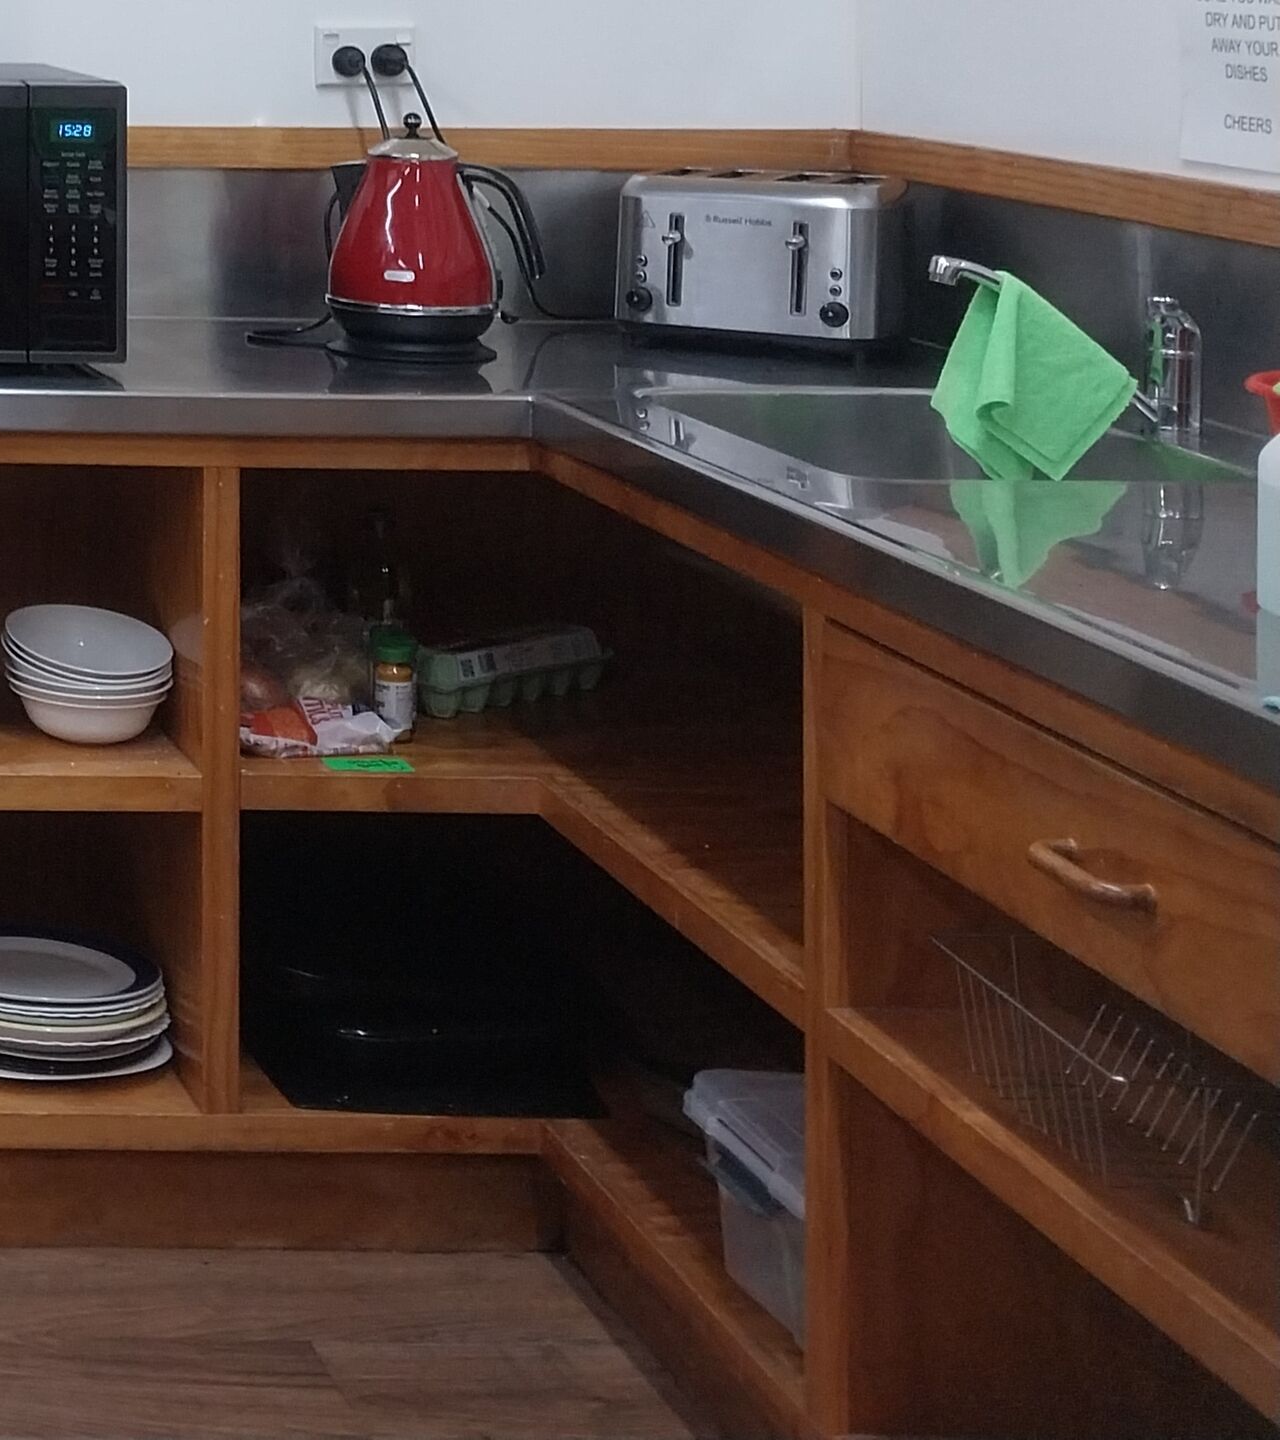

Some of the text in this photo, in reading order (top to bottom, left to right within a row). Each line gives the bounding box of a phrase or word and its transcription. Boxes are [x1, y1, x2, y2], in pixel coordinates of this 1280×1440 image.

[1205, 12, 1228, 27] DRY
[1232, 14, 1255, 30] AND
[1212, 38, 1280, 57] AWAY YOUR
[1225, 64, 1268, 82] DISHES
[58, 124, 92, 137] 15:28
[1224, 114, 1272, 134] CHEERS
